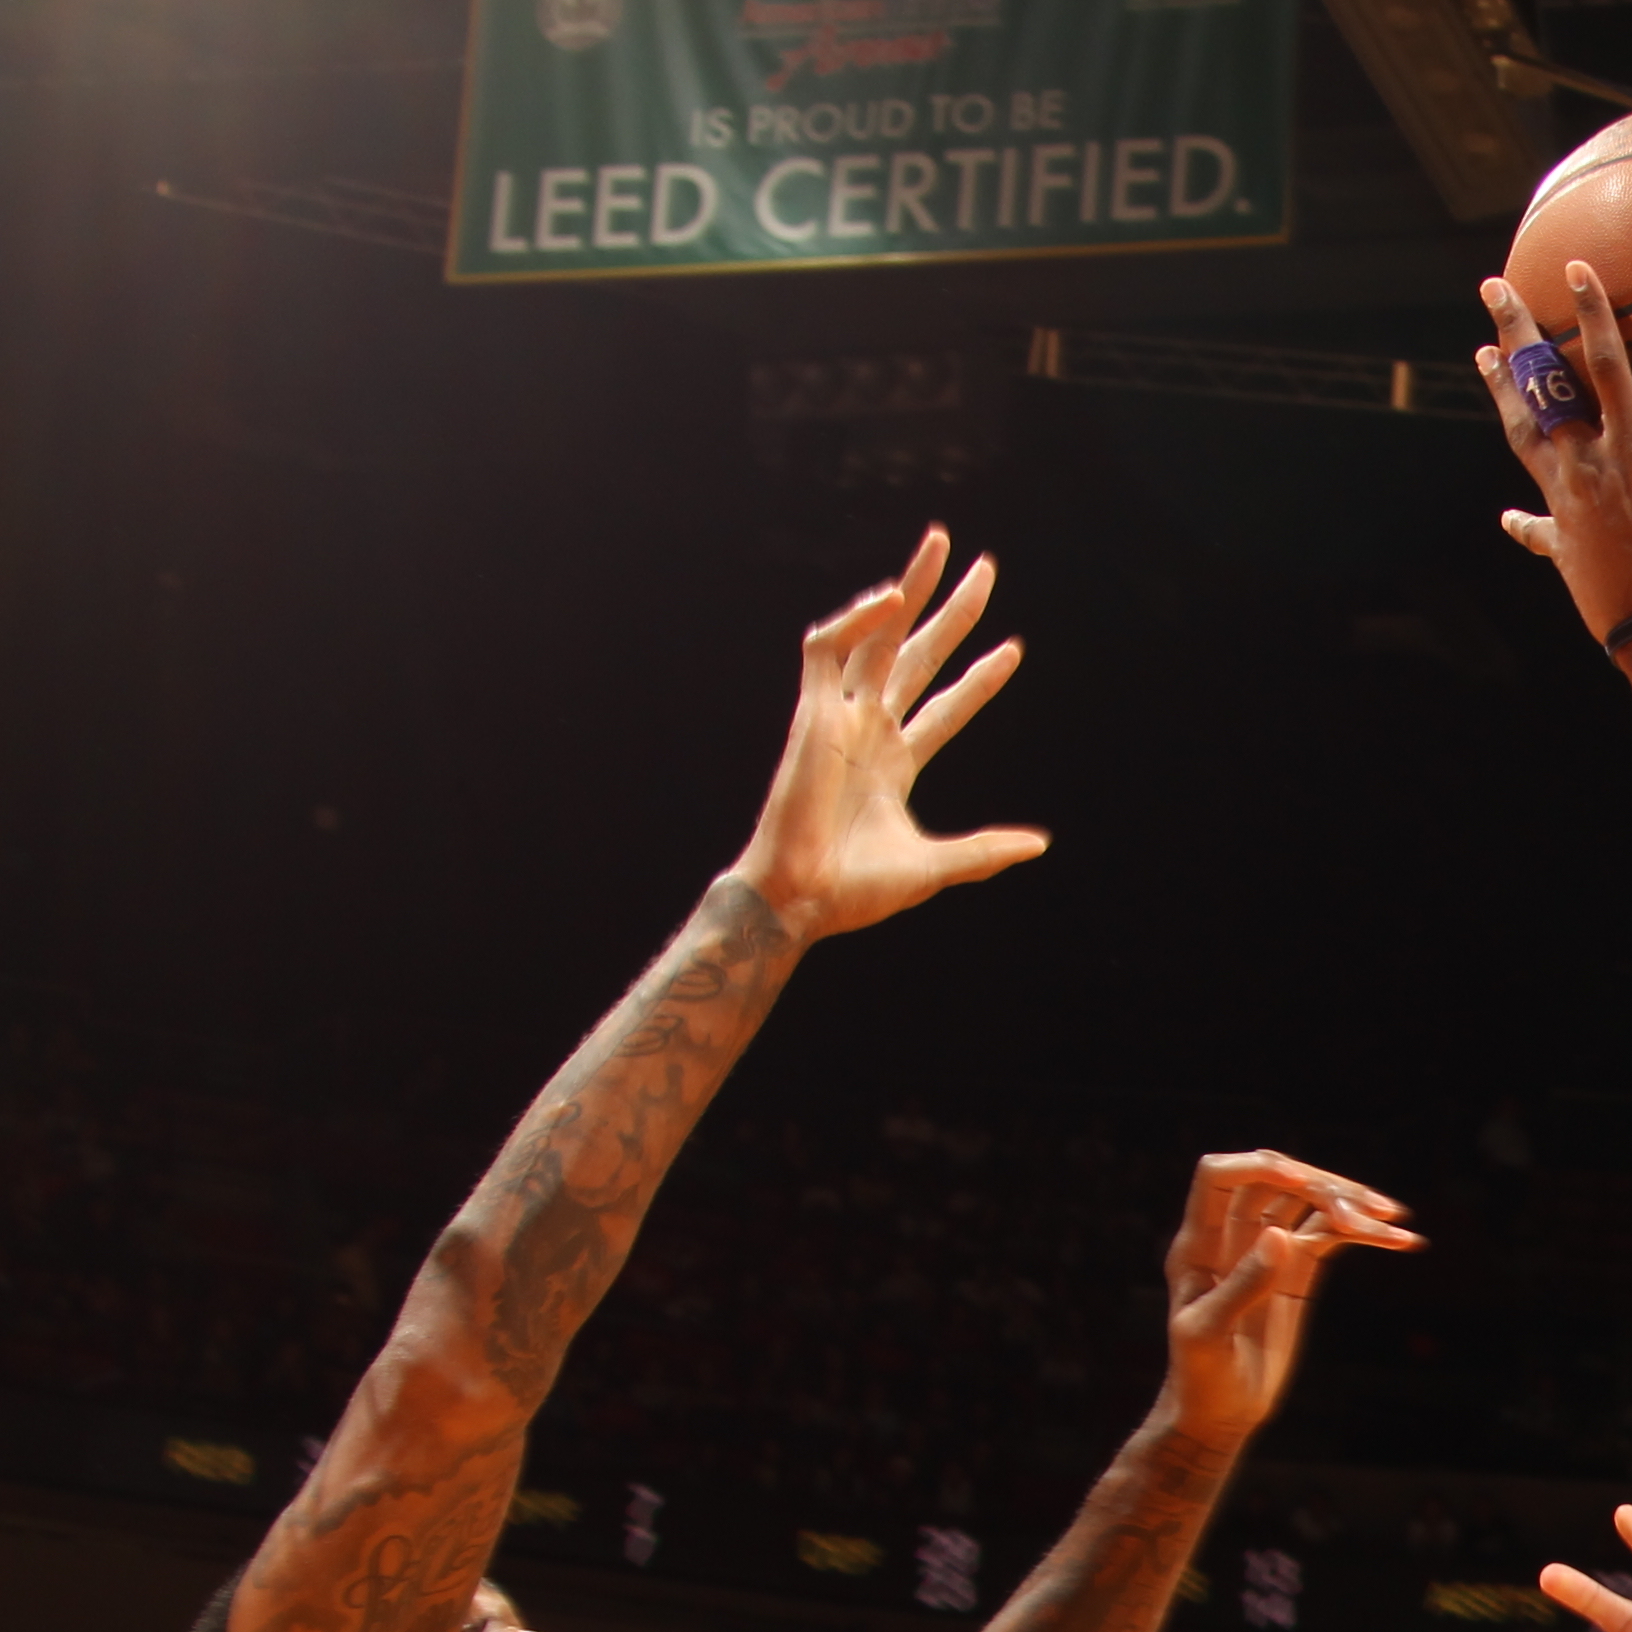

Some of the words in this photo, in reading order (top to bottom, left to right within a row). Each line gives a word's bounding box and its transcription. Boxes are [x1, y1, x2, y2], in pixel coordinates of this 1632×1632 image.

[689, 107, 734, 150] IS
[748, 97, 914, 146] PROUD
[931, 93, 994, 135] TO
[1010, 90, 1064, 132] BE
[488, 163, 717, 255] LEED
[754, 134, 1255, 243] CERTIFIED.
[1525, 370, 1577, 411] 16
